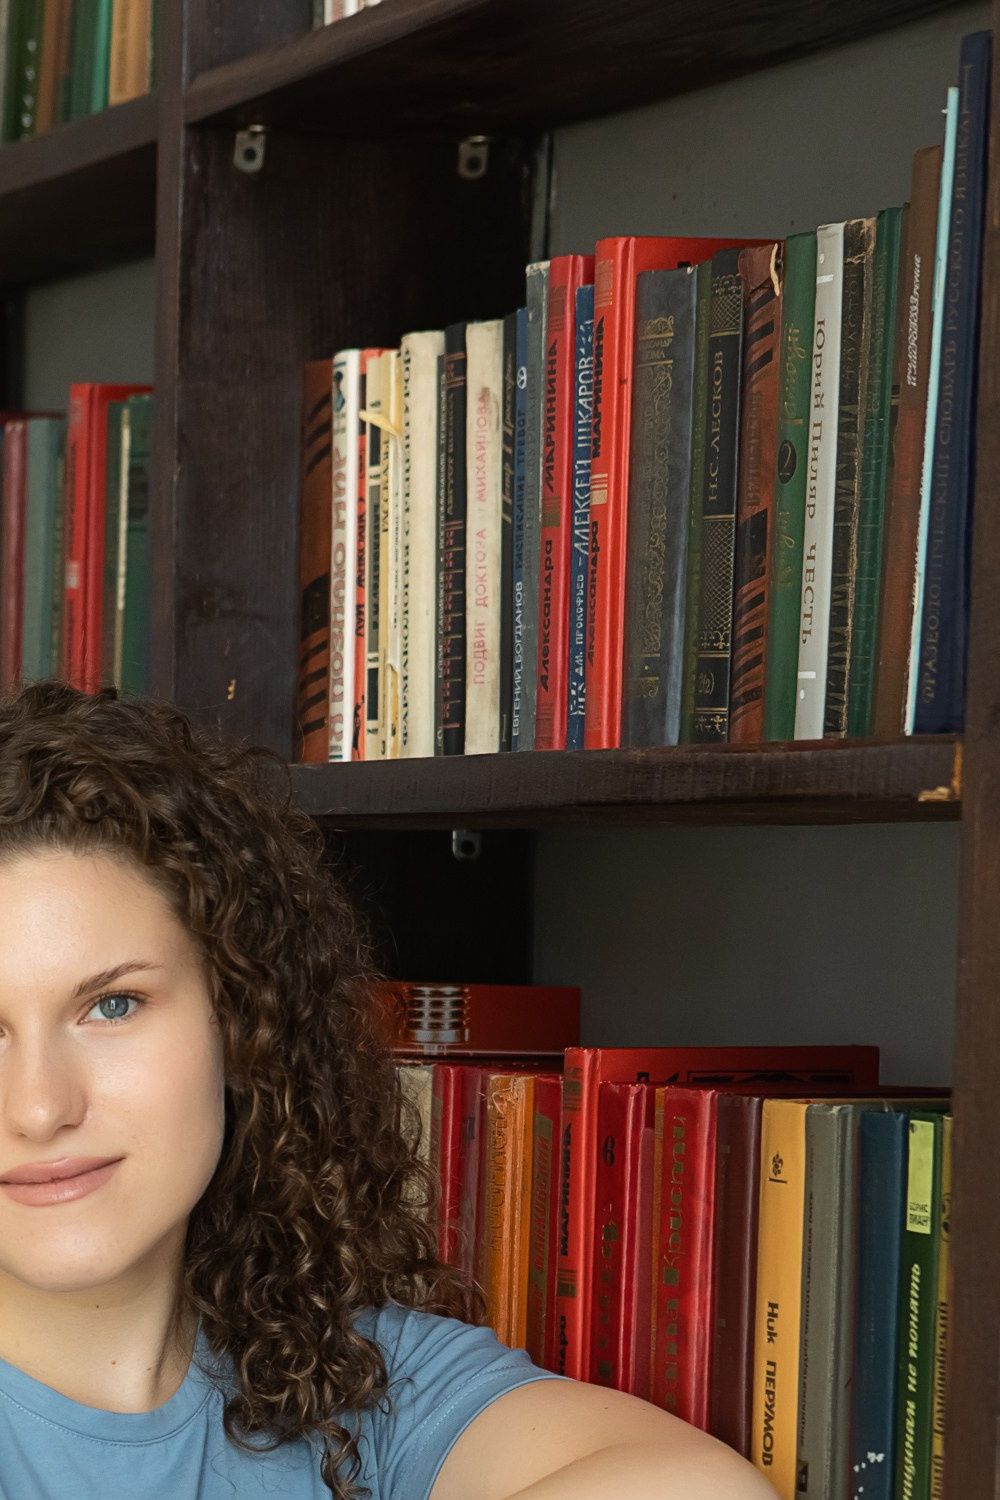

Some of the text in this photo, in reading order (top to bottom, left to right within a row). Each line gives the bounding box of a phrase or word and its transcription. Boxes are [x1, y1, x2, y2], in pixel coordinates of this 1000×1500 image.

[946, 207, 965, 331] РУССКОГО
[516, 410, 526, 464] ТРЕВОГ
[938, 341, 957, 444] СЛОВАРЬ
[332, 448, 346, 531] МИР
[475, 392, 489, 503] МИХАЙЛОВА
[587, 316, 605, 668] Александра МАРИНИНА
[800, 318, 826, 645] Юрий Пиляр ЧЕСТЬ
[540, 339, 557, 693] Александра МАРИНИНА
[573, 459, 589, 556] АЛЕКСЕЙ
[331, 541, 346, 703] ПОЗНАЮ
[473, 621, 486, 685] ПОДВИГ
[514, 581, 524, 664] БОГДАНОВ
[575, 575, 584, 645] ПРОКОФЬЕВ
[512, 668, 521, 737] ЕВГЕНИЙ
[575, 651, 583, 676] ДМ.
[560, 1123, 573, 1257] МАРИНИНА
[907, 1263, 923, 1358] понять
[762, 1301, 779, 1467] Ник ПЕРУМОВ
[905, 1365, 918, 1392] не
